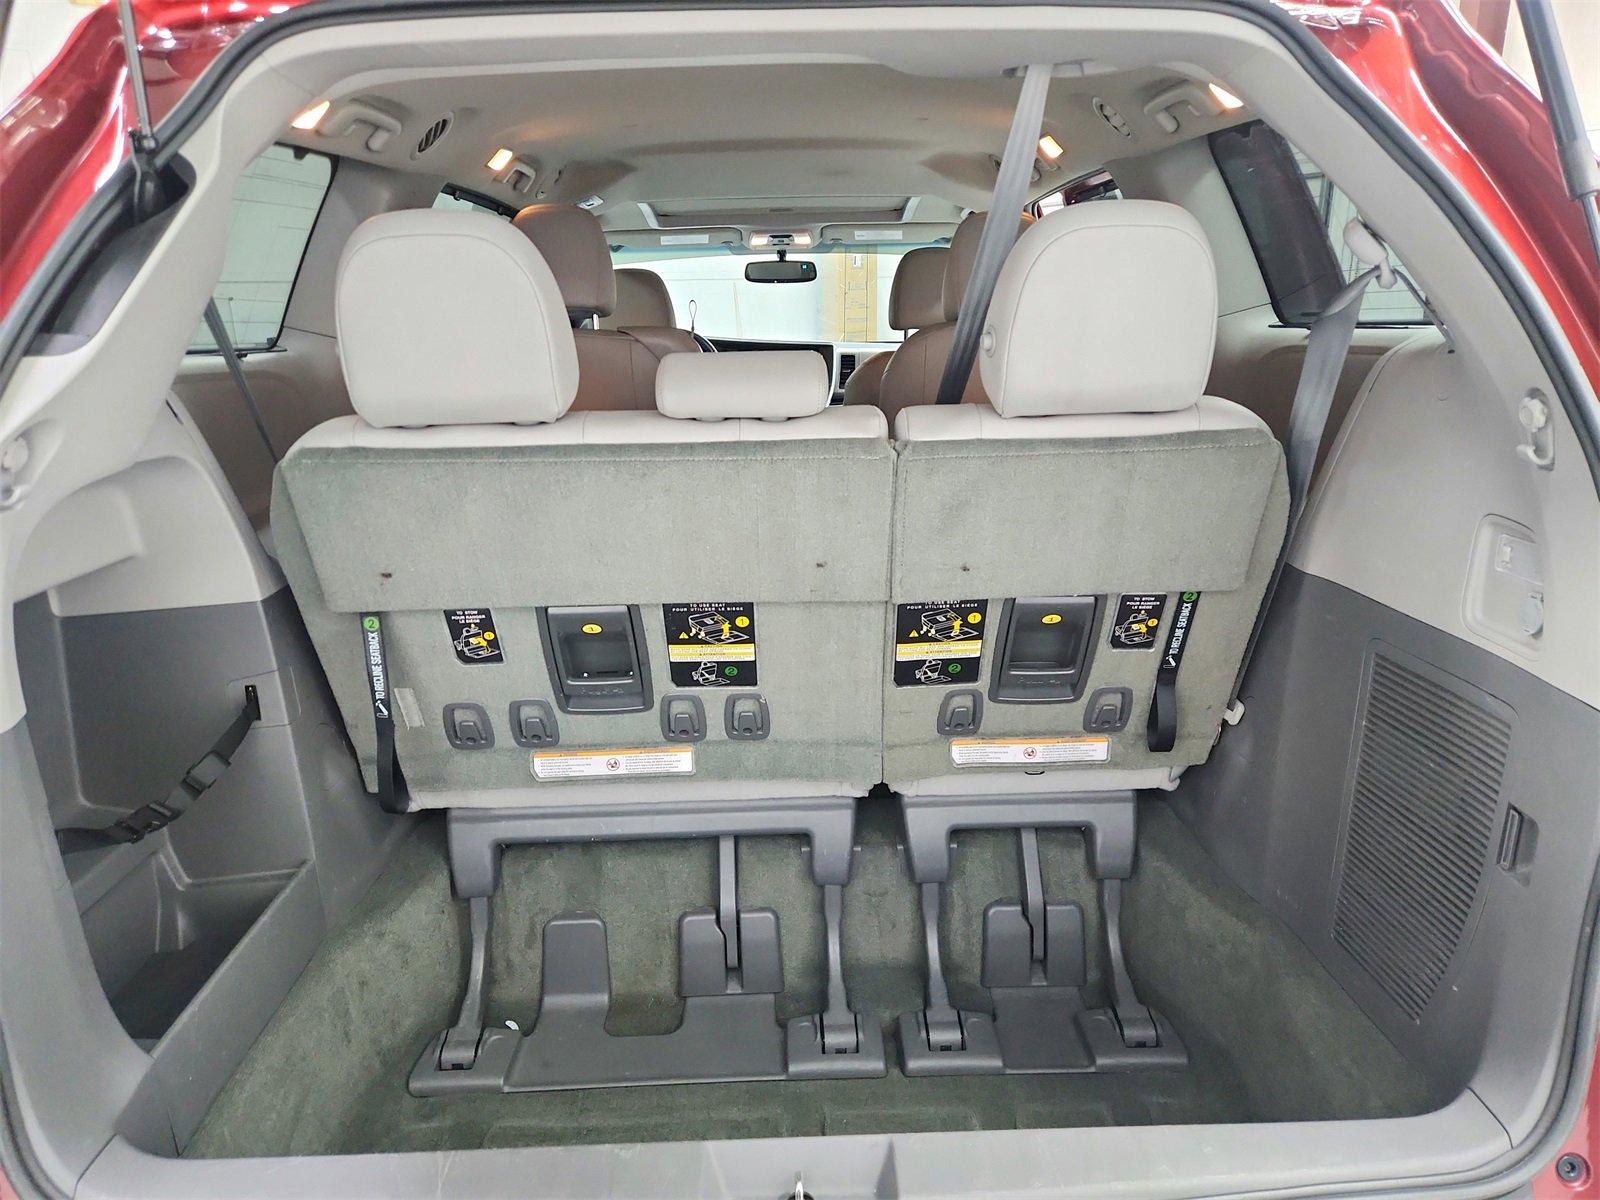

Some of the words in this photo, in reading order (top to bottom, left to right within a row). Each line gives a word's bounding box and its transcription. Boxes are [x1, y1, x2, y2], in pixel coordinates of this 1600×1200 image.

[1176, 602, 1193, 628] SEATBACK
[367, 631, 382, 665] SEATBACK
[1171, 628, 1185, 648] RECLINE
[372, 665, 384, 691] RECLINE
[375, 691, 385, 700] TO
